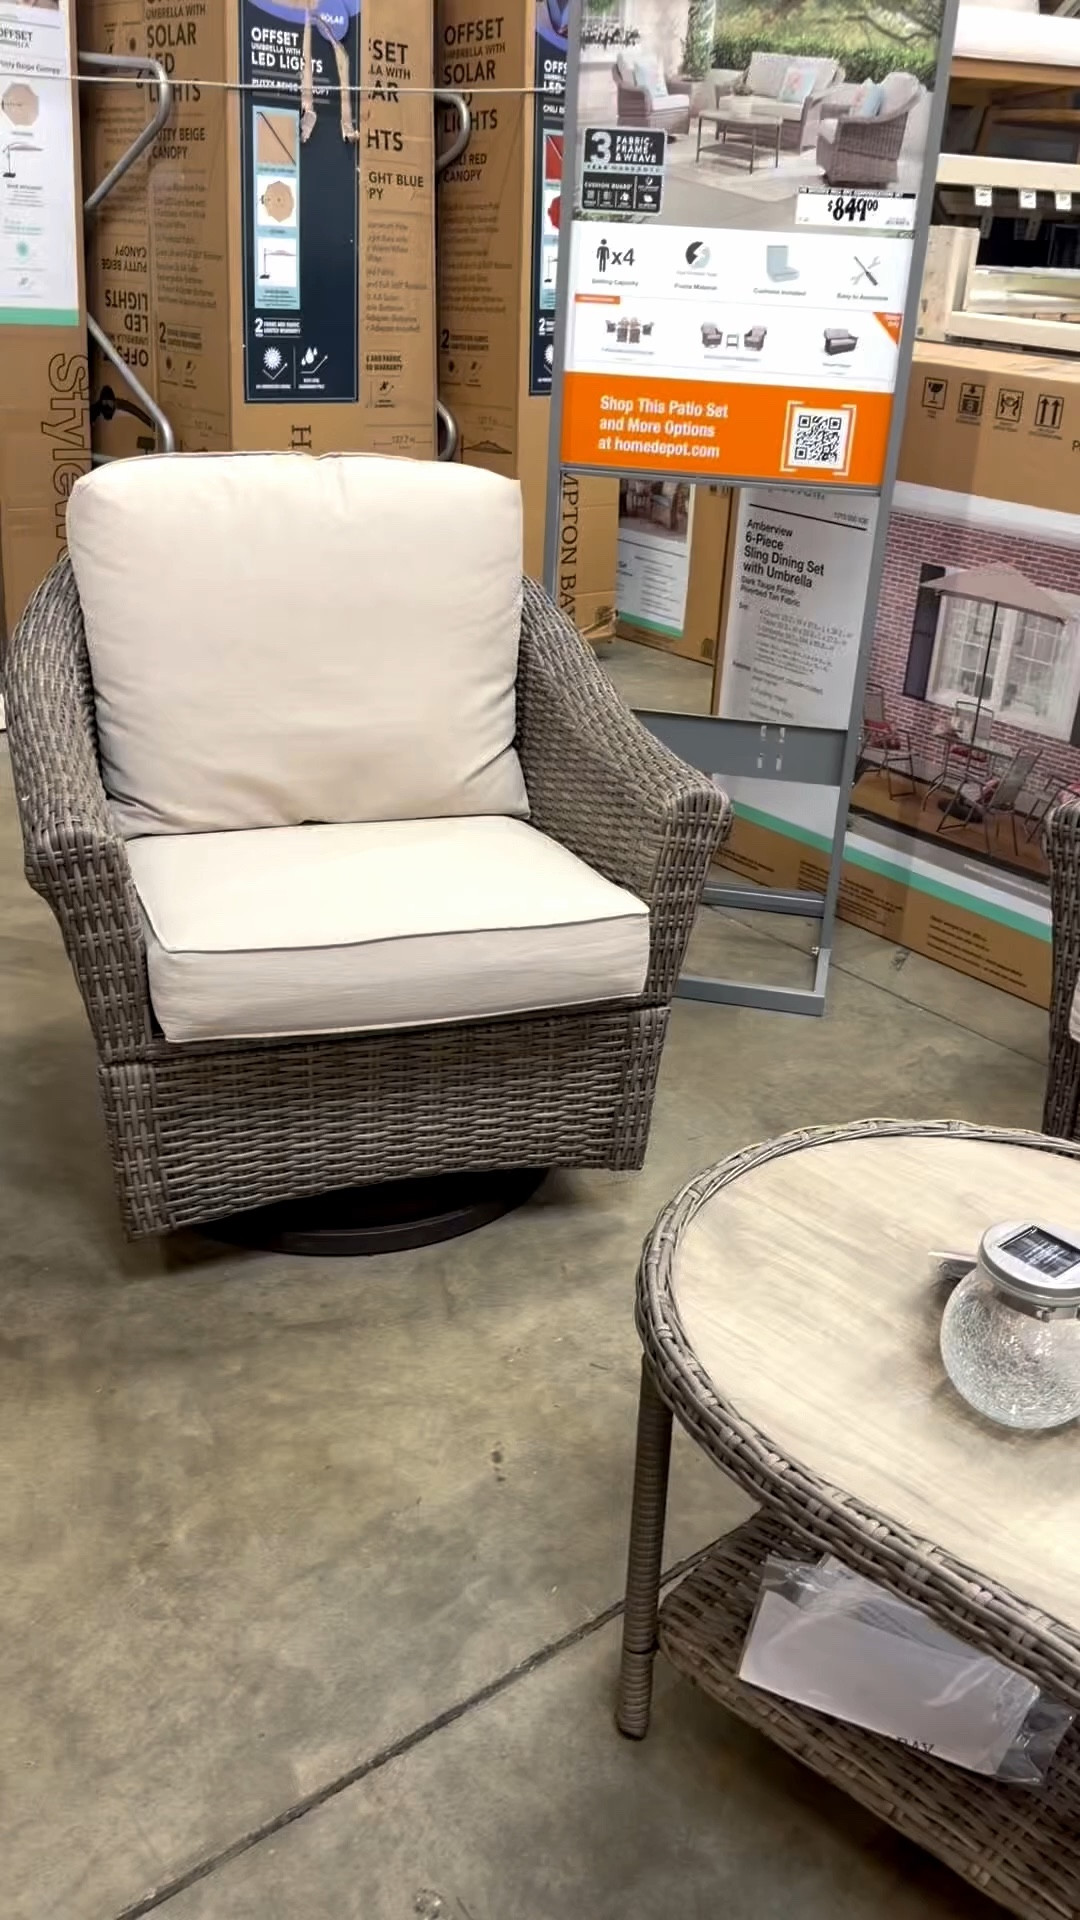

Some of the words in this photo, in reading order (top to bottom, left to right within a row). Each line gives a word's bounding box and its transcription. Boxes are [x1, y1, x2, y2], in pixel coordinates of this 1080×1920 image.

[185, 4, 206, 17] WITH
[147, 22, 197, 48] SOLAR
[251, 27, 299, 46] OFFSET
[444, 17, 504, 46] OFFSET
[369, 38, 408, 64] SET
[485, 42, 506, 55] WITH
[251, 51, 276, 67] LED
[386, 66, 411, 80] WITH
[444, 60, 496, 85] SOLAR
[148, 78, 201, 102] LIHTS
[157, 128, 178, 142] UTTY
[180, 127, 206, 141] BEIGE
[152, 146, 188, 159] CANOPY
[590, 131, 612, 164] 3
[469, 153, 487, 165] RED
[624, 154, 656, 163] WEAVE
[396, 173, 424, 188] BLUE
[115, 244, 147, 258] CANOPY
[611, 248, 635, 266] x4
[101, 258, 121, 271] BEIGE
[124, 261, 147, 273] PUTTY
[105, 289, 148, 312] LIGHTS
[124, 313, 148, 333] LED
[254, 317, 264, 333] 2
[538, 317, 546, 331] 2
[159, 322, 166, 344] 2
[441, 329, 450, 349] 2
[601, 395, 634, 414] Shop
[638, 398, 665, 414] This
[669, 400, 703, 417] Patio
[706, 402, 729, 418] Set
[600, 417, 625, 431] and
[628, 418, 661, 433] More
[665, 420, 715, 437] Options
[598, 437, 611, 450] at
[615, 437, 720, 458] homedepot.com
[747, 519, 793, 537] Amberview
[745, 531, 784, 551] 6-Piece
[744, 545, 769, 564] Sling
[771, 552, 805, 573] Dining
[807, 560, 825, 576] Set
[743, 562, 764, 575] with
[766, 565, 813, 588] Umbrella
